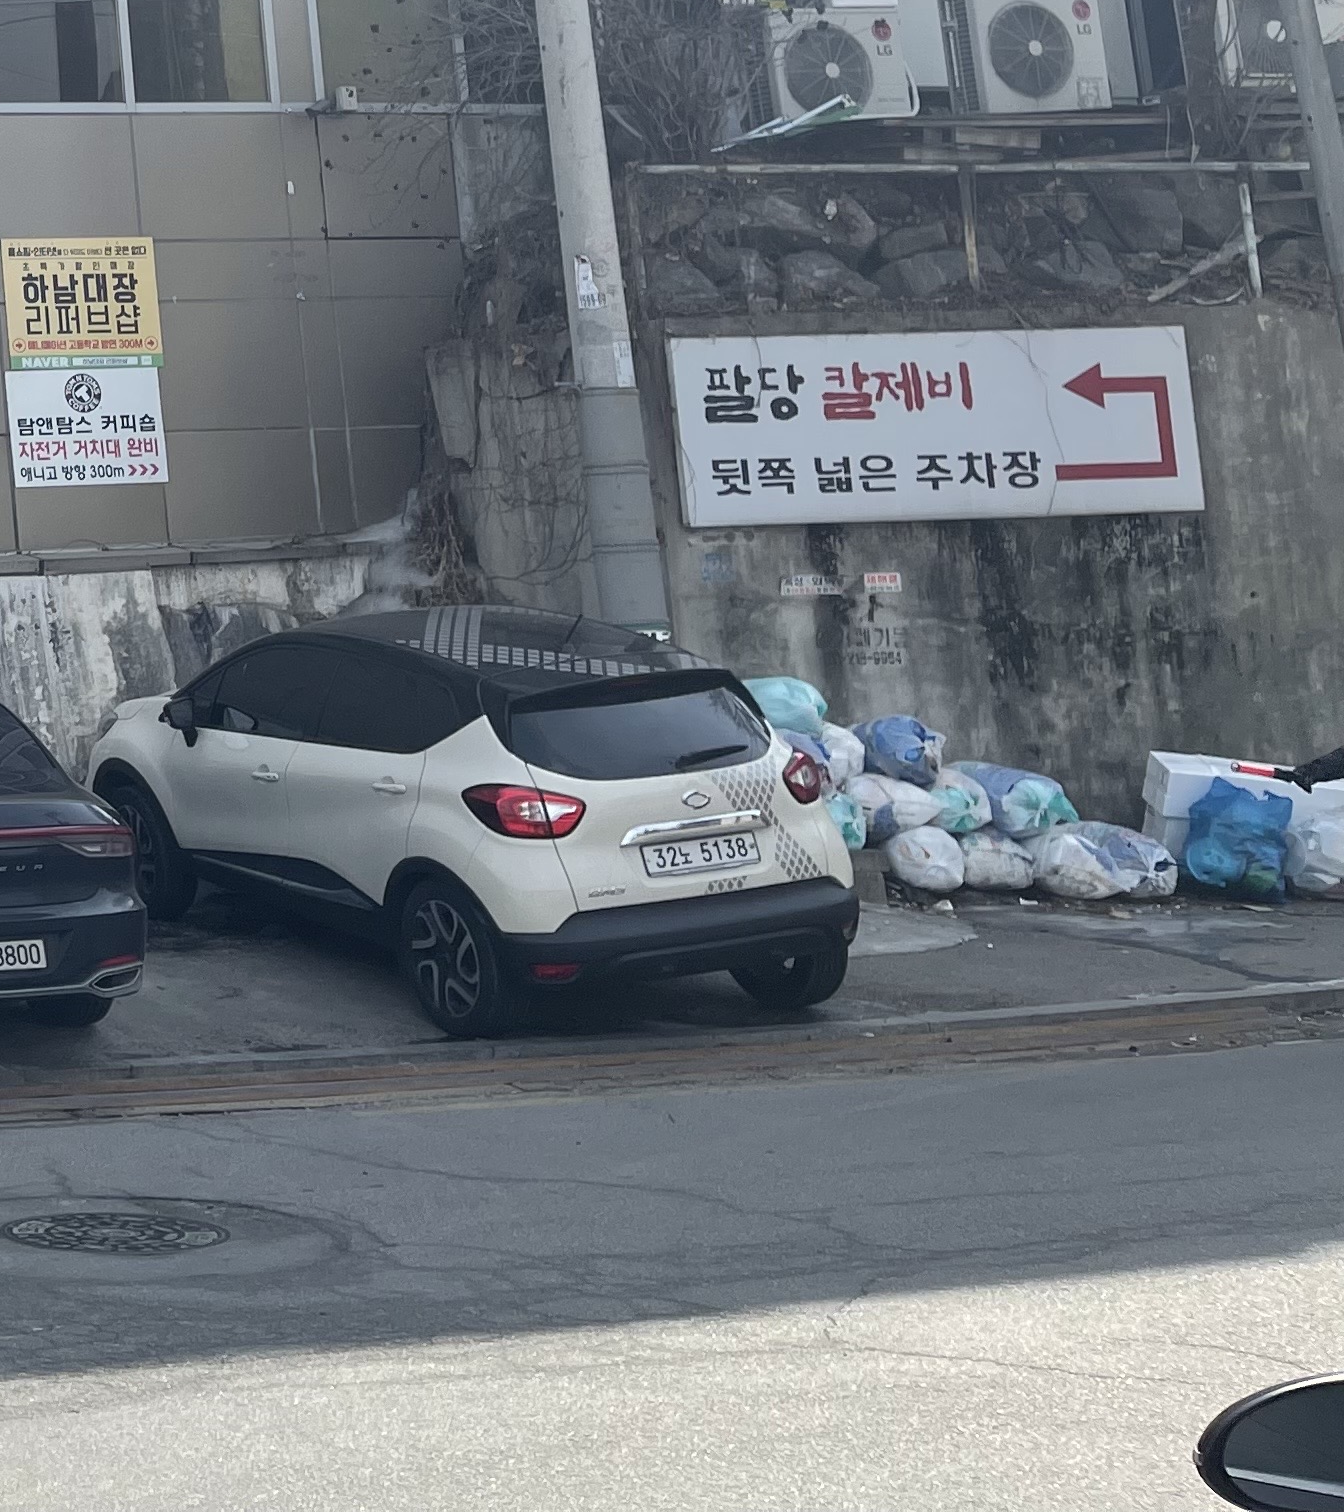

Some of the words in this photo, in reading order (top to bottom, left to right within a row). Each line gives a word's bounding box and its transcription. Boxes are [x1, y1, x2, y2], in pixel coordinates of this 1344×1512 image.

[21, 273, 138, 304] 하남대장
[25, 305, 141, 335] 리퍼브샵
[22, 357, 69, 368] NAVER
[703, 363, 805, 424] 팔당
[821, 361, 974, 420] 칼제비
[17, 416, 93, 437] 탐앤탐스
[100, 414, 156, 434] 커피숍
[18, 441, 68, 461] 자전거
[73, 439, 121, 459] 거치대
[127, 437, 159, 457] 완비
[20, 464, 58, 483] 애니고
[90, 463, 125, 479] 300m
[711, 456, 796, 498] 뒷쪽
[813, 454, 898, 494] 넓은
[915, 450, 1041, 491] 주차장
[655, 844, 693, 870] 32노
[701, 836, 750, 863] 5138
